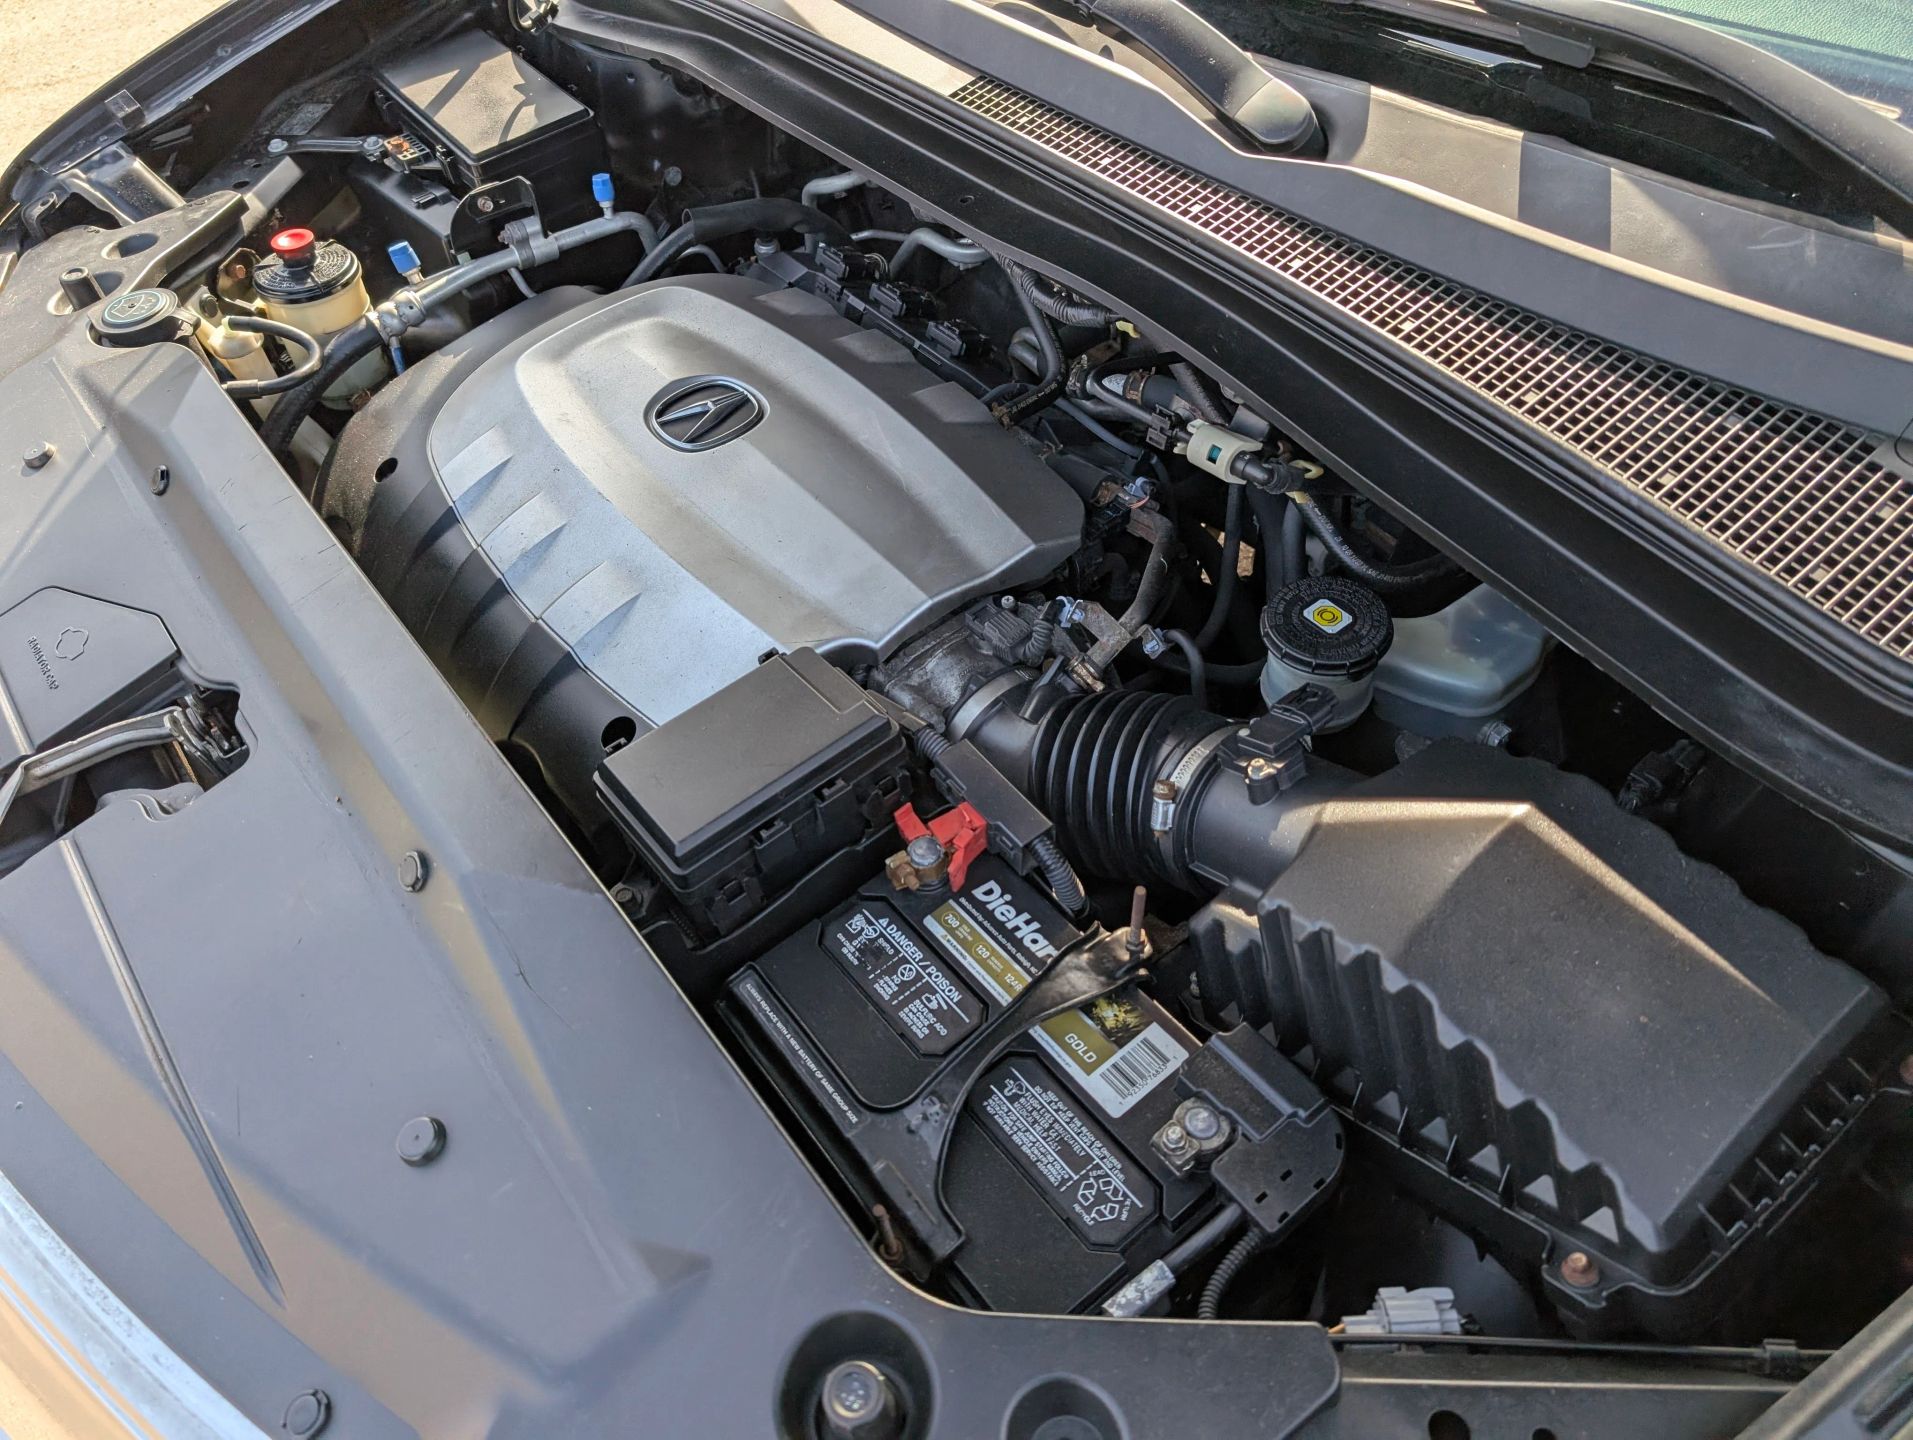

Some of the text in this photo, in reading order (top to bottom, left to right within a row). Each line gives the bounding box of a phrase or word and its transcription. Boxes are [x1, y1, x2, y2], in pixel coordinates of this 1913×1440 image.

[26, 636, 60, 689] RADIATOR CAP
[942, 912, 961, 929] 700
[970, 878, 1059, 957] DieHar
[981, 918, 1000, 936] Advance
[995, 933, 1009, 945] Auto
[884, 922, 924, 962] DANGER
[924, 964, 963, 1003] POISON
[973, 943, 991, 959] 120
[889, 973, 902, 985] NO
[906, 1002, 931, 1026] CAN CAUSE
[911, 998, 949, 1036] SULFURIC ACID
[919, 1025, 930, 1035] OR
[744, 982, 763, 1002] ALWAYS
[757, 999, 779, 1023] REPLACE
[774, 1020, 789, 1035] WITH
[787, 1036, 801, 1051] NEW
[796, 1048, 818, 1072] BATTERY
[813, 1069, 824, 1080] OF
[819, 1077, 835, 1094] SAME
[830, 1091, 849, 1112] GROUP
[844, 1109, 859, 1124] SIZE
[1064, 1032, 1098, 1064] GOLD
[985, 1097, 1015, 1127] INSTRUCTIONS
[1014, 1129, 1034, 1148] VEHICLE
[1011, 1100, 1062, 1152] MEDICAL HELP FAST
[1017, 1095, 1034, 1112] WITH
[1047, 1127, 1062, 1141] GET
[1023, 1090, 1087, 1157] FLUSH EYES IMMEDIATELY
[1032, 1084, 1044, 1095] DO
[1039, 1091, 1052, 1103] NOT
[1056, 1109, 1071, 1123] KEEP
[1067, 1121, 1081, 1134] VENT
[1077, 1131, 1092, 1147] CAPS
[1088, 1143, 1104, 1159] TIGHT
[1101, 1157, 1114, 1169] AND
[1110, 1166, 1127, 1182] LEVEL
[1045, 1089, 1123, 1170] KEEP OUT OF THE REACH OF CHILDREN
[984, 1104, 996, 1116] NOT
[992, 1113, 1014, 1136] AVAILABLE
[1010, 1132, 1024, 1146] SEEK
[1019, 1143, 1039, 1162] SERVICE
[1034, 1159, 1061, 1187] ASSISTANCE
[1005, 1110, 1018, 1122] FOR
[1013, 1119, 1027, 1132] SAFE
[1022, 1129, 1038, 1144] JUMP
[1033, 1140, 1055, 1163] STARTING
[1051, 1159, 1071, 1179] FOLLOW
[1070, 1202, 1095, 1227] RECYCLE
[1119, 1198, 1132, 1221] RETURN
